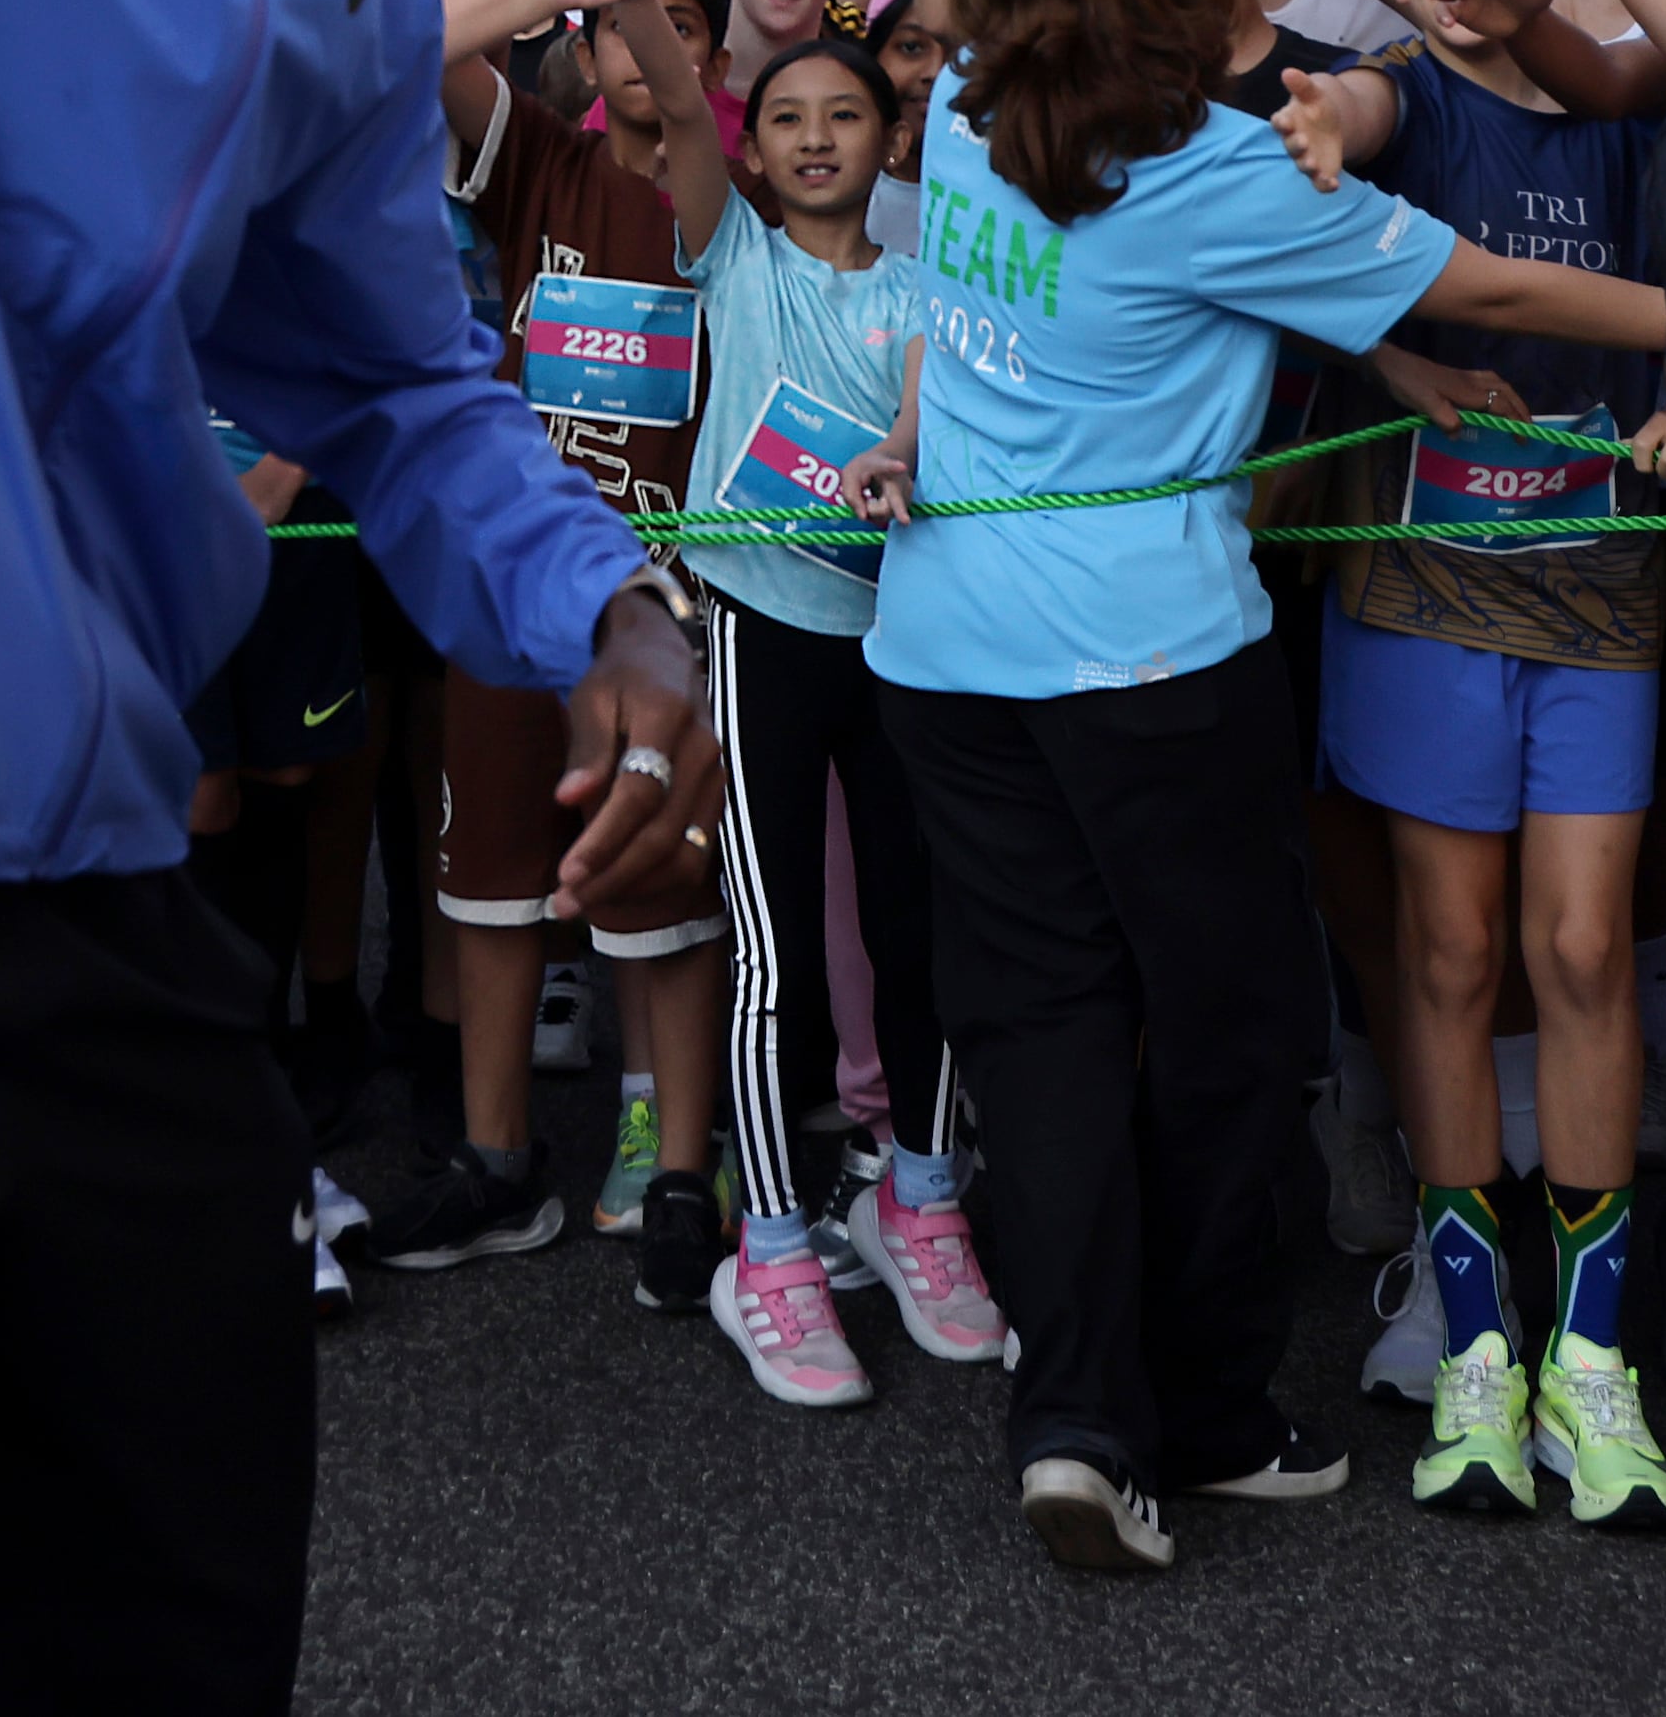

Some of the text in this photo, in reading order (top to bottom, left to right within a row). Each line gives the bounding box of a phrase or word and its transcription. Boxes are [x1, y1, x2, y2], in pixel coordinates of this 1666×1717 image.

[1516, 190, 1589, 226] TRI
[922, 177, 1065, 319] TEAM
[561, 326, 648, 365] 2226
[930, 296, 1027, 384] 2026
[1465, 466, 1567, 498] 2024
